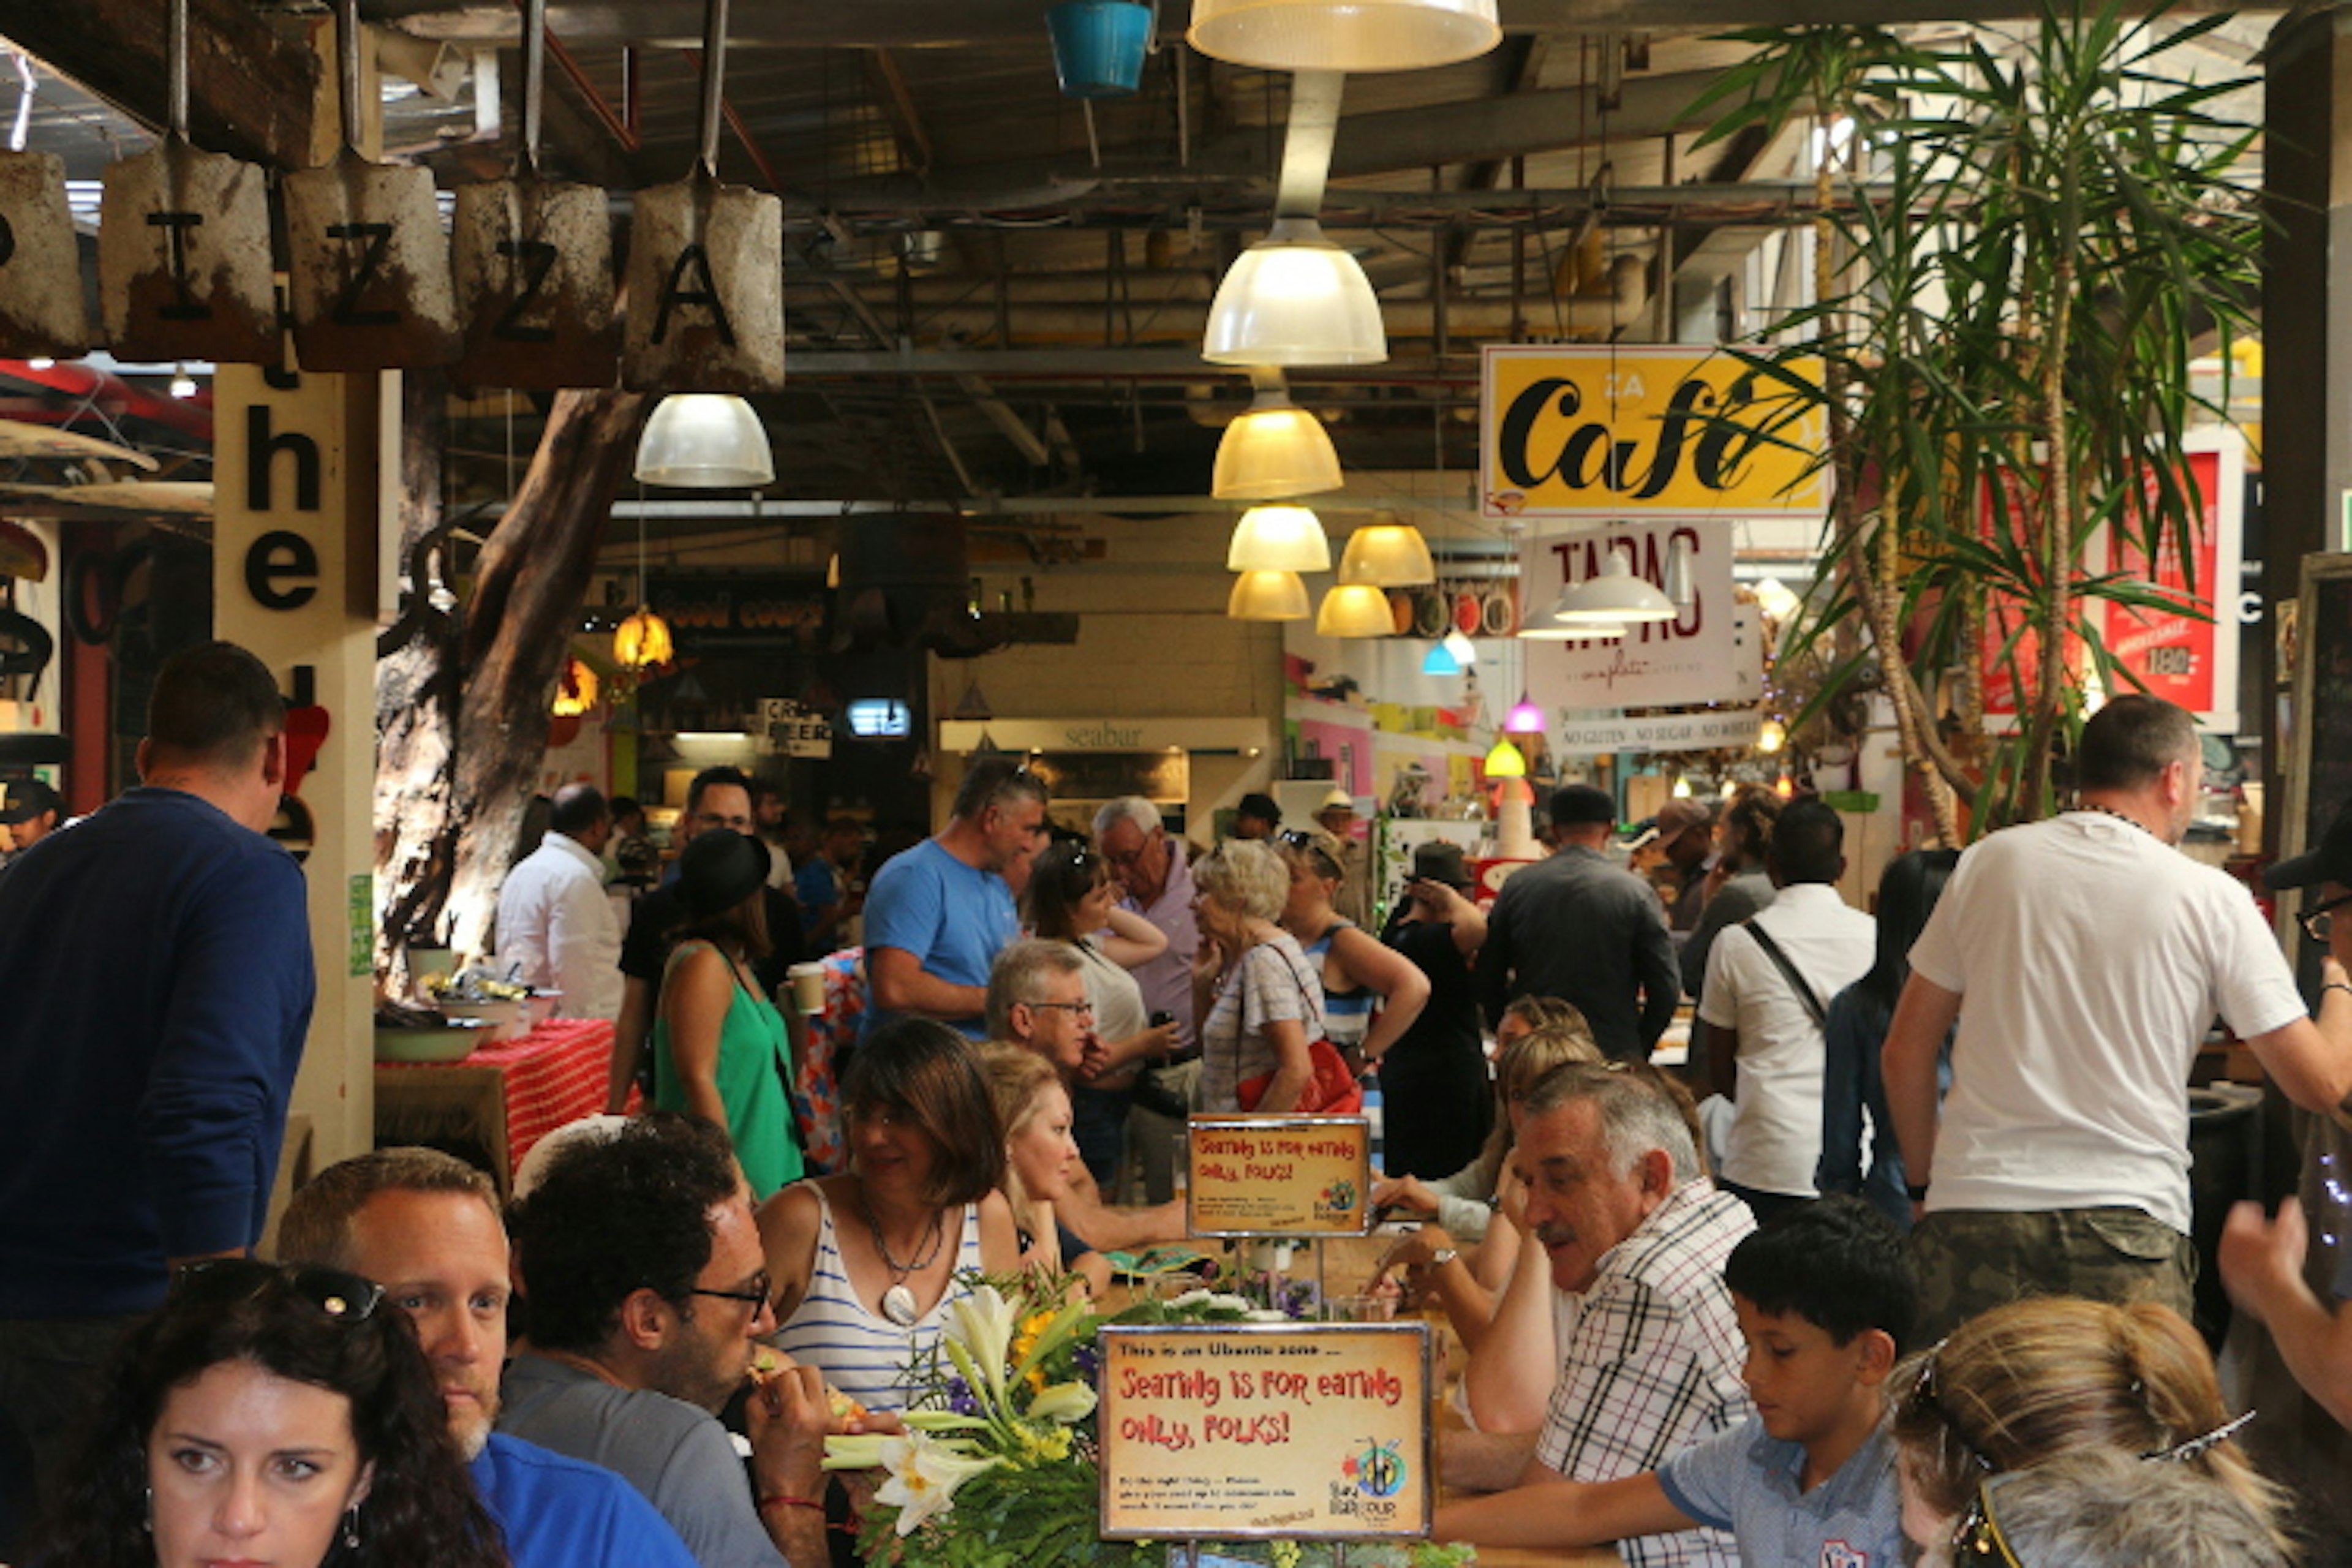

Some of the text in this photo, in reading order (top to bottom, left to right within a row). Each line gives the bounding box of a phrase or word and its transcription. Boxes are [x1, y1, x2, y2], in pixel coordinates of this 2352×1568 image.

[1065, 722, 1142, 747] seabar
[1563, 731, 1580, 744] NO
[1637, 727, 1653, 741] NO
[1656, 725, 1692, 741] SUGAR
[1702, 723, 1719, 737] NO
[1120, 1343, 1155, 1357] This
[1161, 1342, 1176, 1357] is
[1182, 1346, 1202, 1357] an
[1209, 1342, 1273, 1357] Ubuntu
